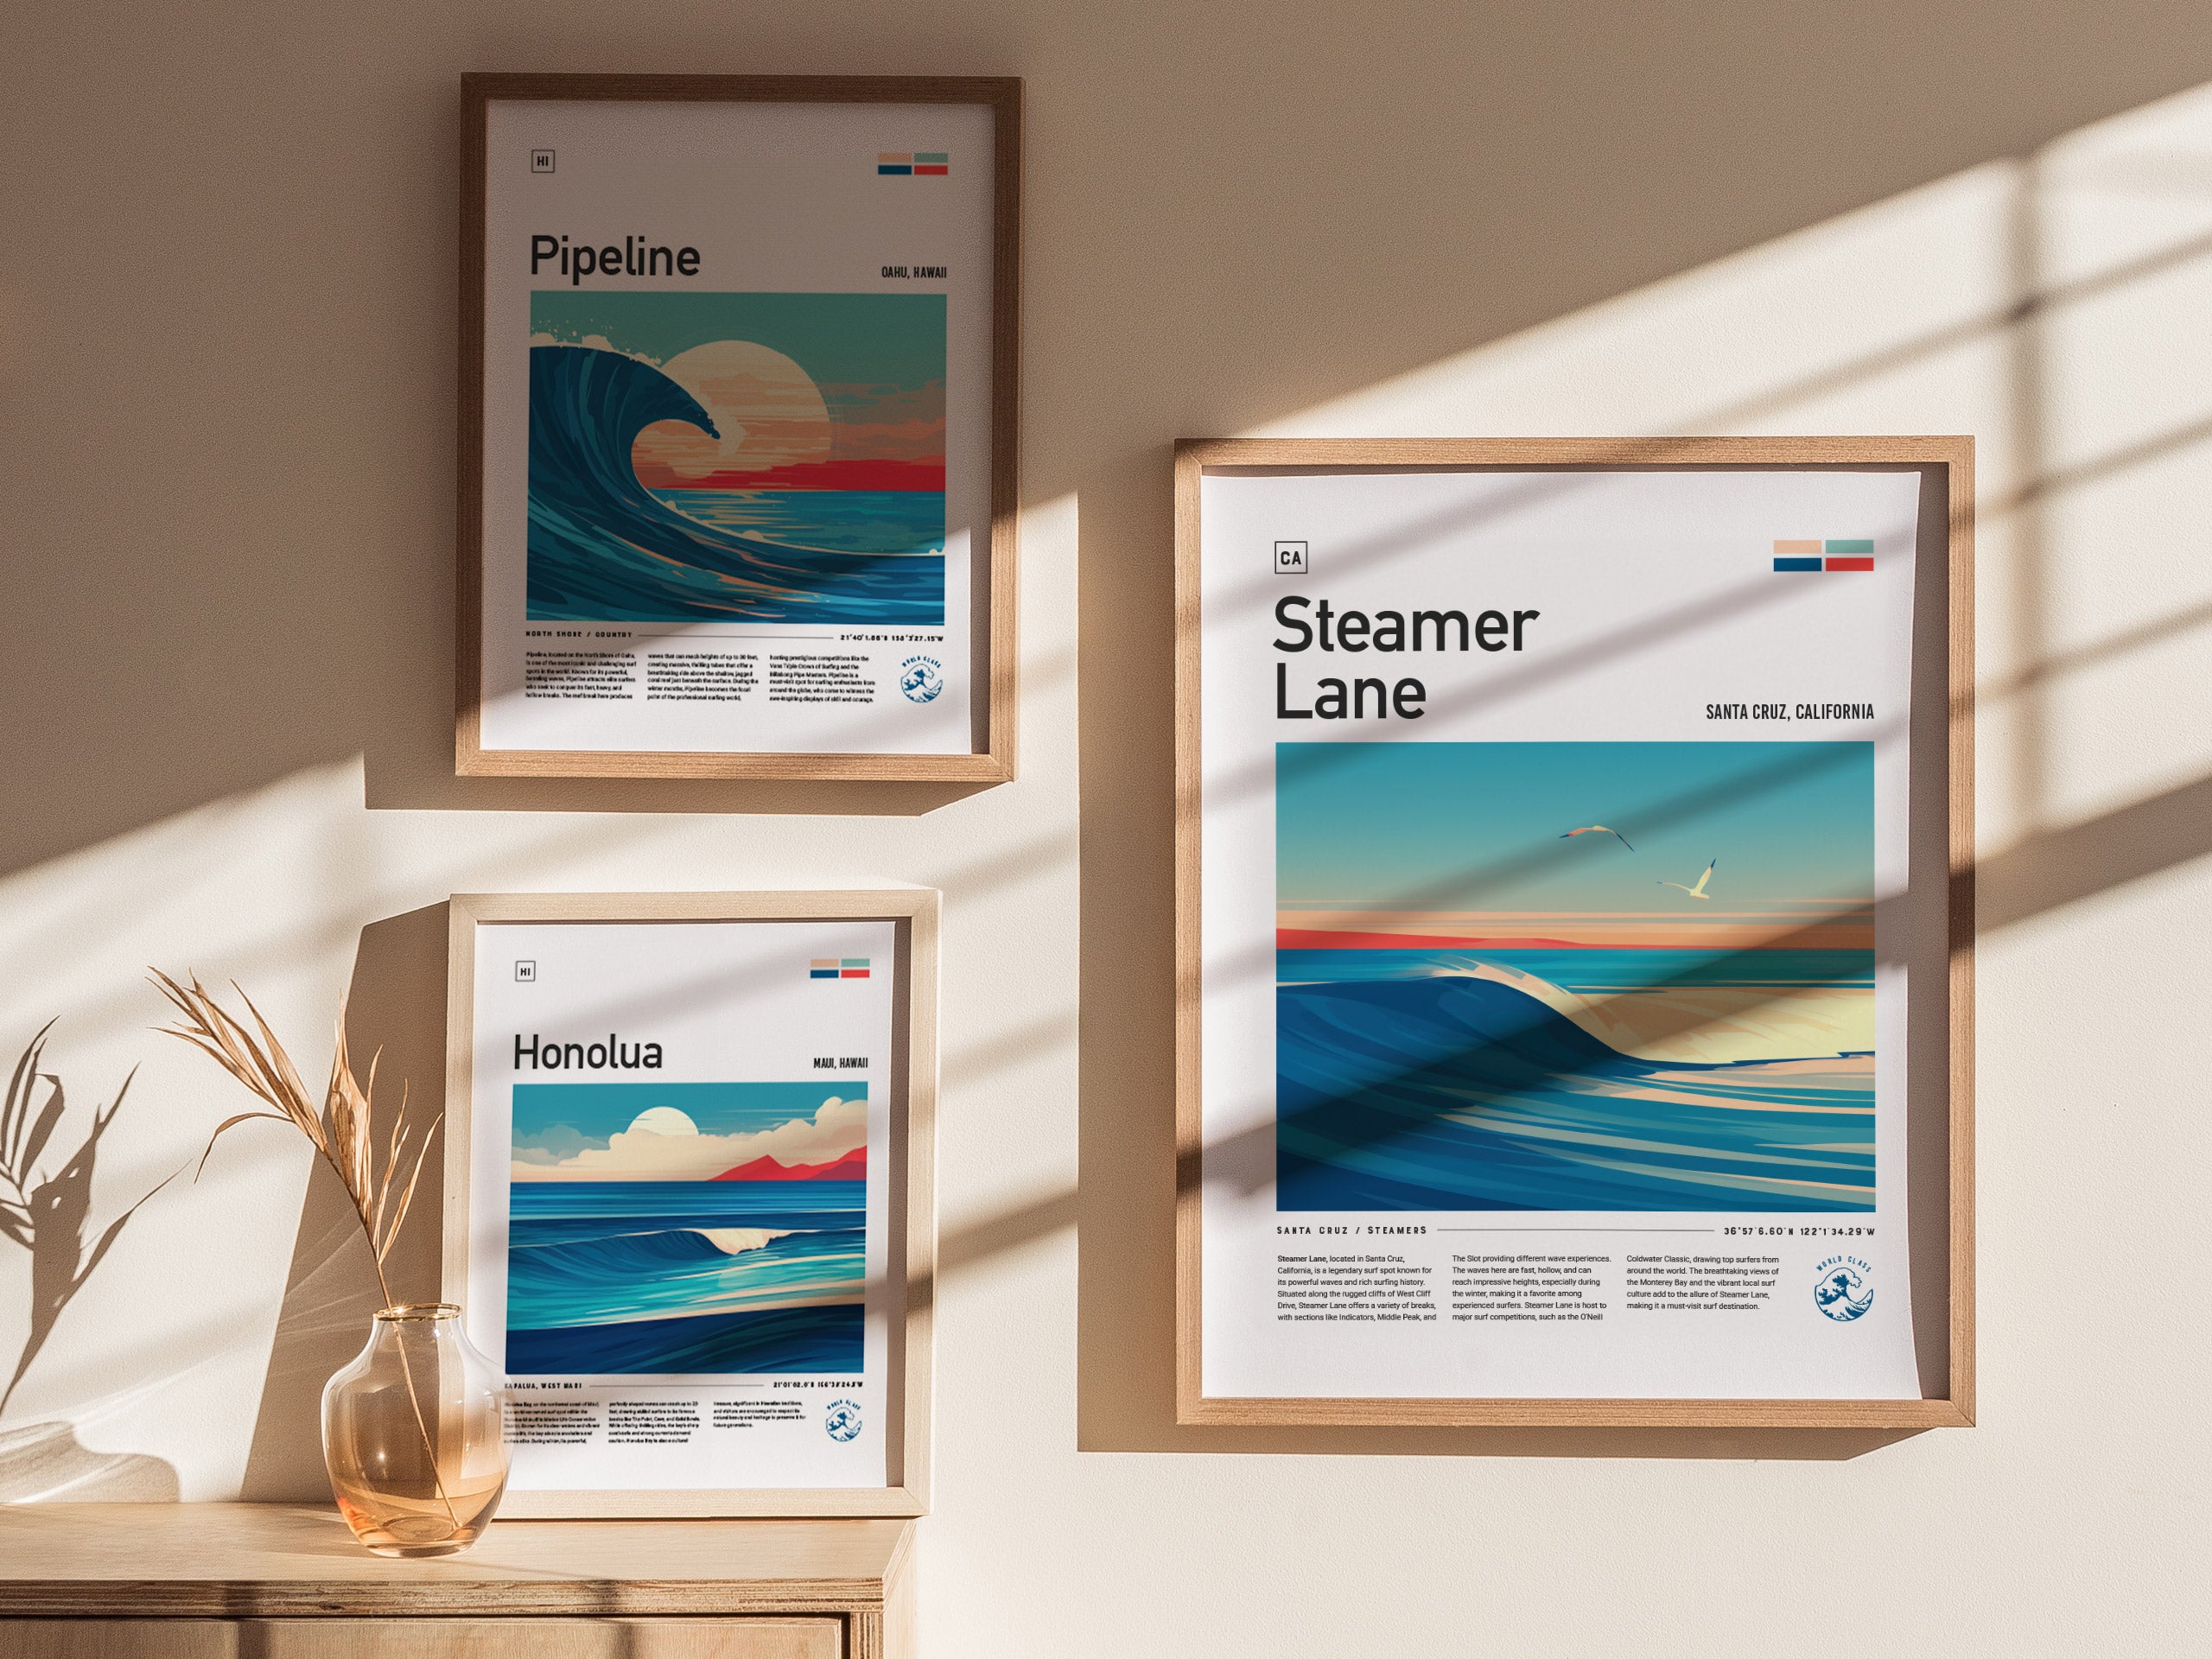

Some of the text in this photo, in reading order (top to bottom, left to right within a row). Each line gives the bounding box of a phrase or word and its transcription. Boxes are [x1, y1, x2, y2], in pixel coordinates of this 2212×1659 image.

[537, 156, 549, 166] HI
[531, 235, 700, 285] Pipeline
[881, 266, 947, 279] OAHU, HAWAII
[1281, 550, 1302, 565] CA
[1272, 595, 1541, 652] Steamer
[1276, 662, 1426, 720] Lane
[1706, 703, 1875, 721] SANTA CRUZ, CALIFORNIA
[520, 968, 531, 976] HI
[514, 1033, 663, 1070] Honolua
[814, 1058, 868, 1070] MAUI, HAWAII
[1276, 1226, 1312, 1235] SANTA
[1319, 1226, 1348, 1235] CRUZ
[1367, 1226, 1427, 1235] STEAMERS
[1308, 1255, 1328, 1263] Lane,
[1387, 1255, 1405, 1263] Cruz,
[1483, 1255, 1515, 1263] providing
[1516, 1255, 1547, 1264] different
[1567, 1255, 1611, 1263] experiences.
[1626, 1255, 1662, 1264] Coldwater
[1664, 1255, 1692, 1264] Classic,
[1693, 1255, 1721, 1265] drawing
[1816, 1255, 1872, 1273] WORLD CLASS
[1277, 1267, 1313, 1275] California,
[1328, 1266, 1363, 1275] legendary
[1521, 1265, 1536, 1275] fast,
[1538, 1267, 1562, 1275] hollow,
[1704, 1267, 1749, 1276] breathtaking
[1287, 1279, 1319, 1287] powerful
[1374, 1279, 1398, 1287] surfing
[1400, 1279, 1426, 1287] history.
[1541, 1278, 1577, 1287] especially
[1578, 1279, 1600, 1287] during
[1640, 1279, 1673, 1287] Monterey
[1674, 1279, 1688, 1287] Bay
[1308, 1290, 1328, 1300] along
[1342, 1290, 1367, 1299] rugged
[1490, 1289, 1516, 1298] making
[1751, 1291, 1770, 1300] Lane,
[1277, 1301, 1297, 1310] Drive,
[1298, 1300, 1329, 1309] Steamer
[1376, 1301, 1401, 1310] variety
[1410, 1301, 1436, 1310] breaks,
[1452, 1301, 1495, 1310] experienced
[1626, 1301, 1653, 1310] making
[1339, 1313, 1376, 1322] Indicators,
[1402, 1313, 1422, 1322] Peak,
[1452, 1313, 1472, 1322] major
[1490, 1313, 1537, 1322] competitions,
